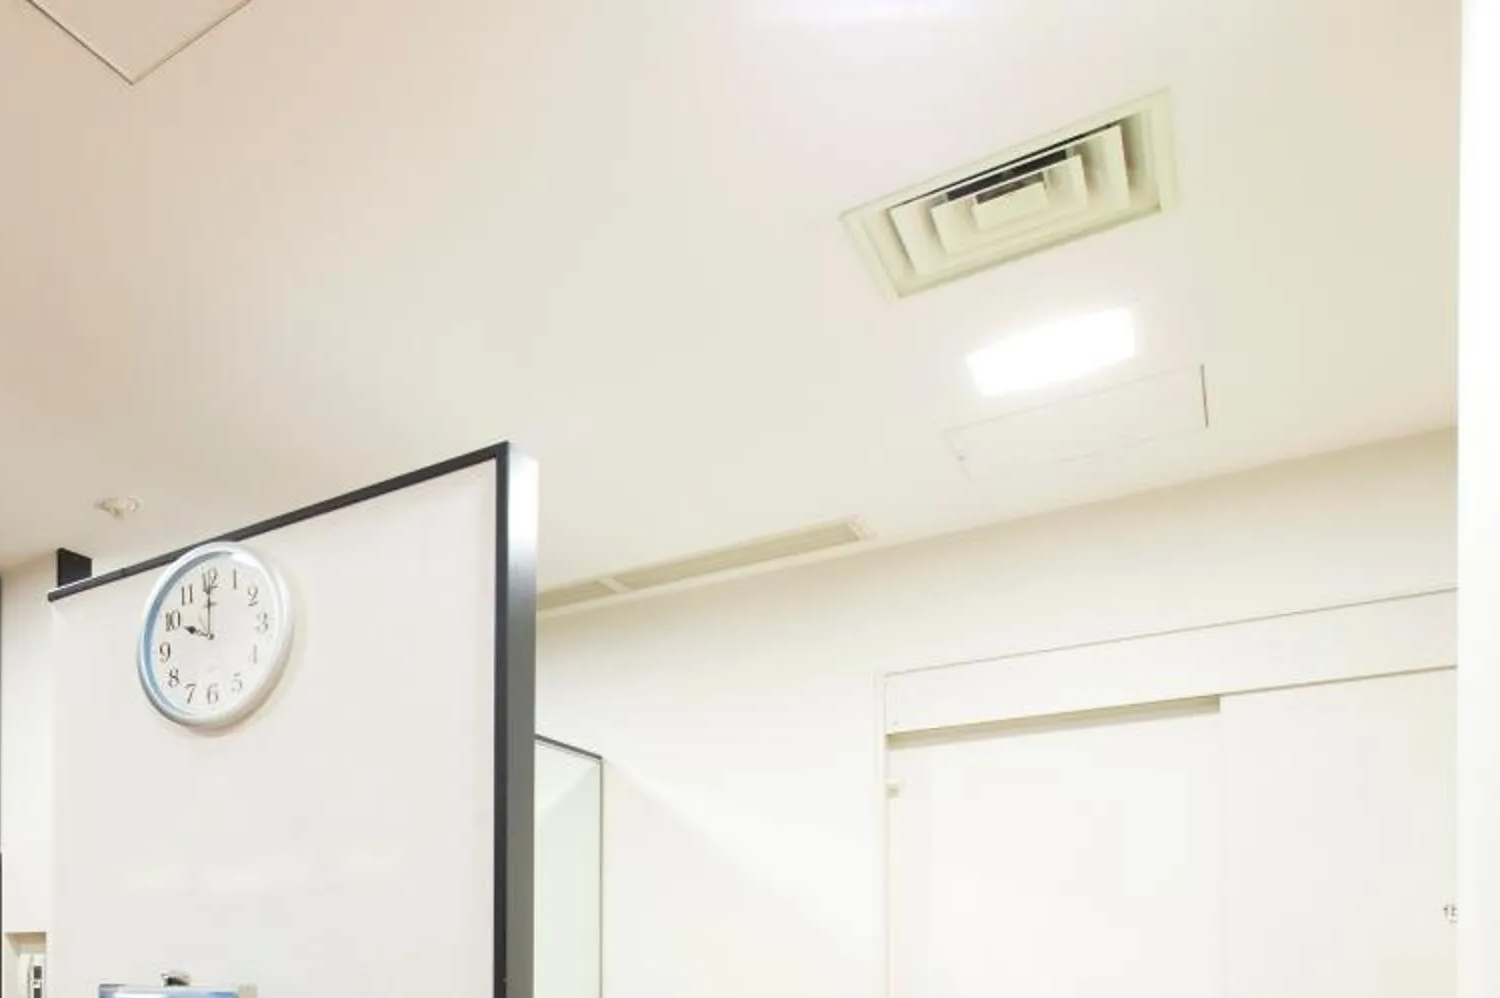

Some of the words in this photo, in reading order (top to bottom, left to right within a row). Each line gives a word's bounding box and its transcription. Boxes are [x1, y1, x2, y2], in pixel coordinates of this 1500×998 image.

[181, 583, 193, 606] 11
[247, 586, 259, 607] 2
[165, 610, 181, 632] 10
[256, 611, 268, 634] 3
[159, 642, 171, 663] 9
[168, 667, 180, 688] 8
[231, 672, 243, 693] 5
[184, 683, 197, 704] 7
[206, 683, 219, 704] 6
